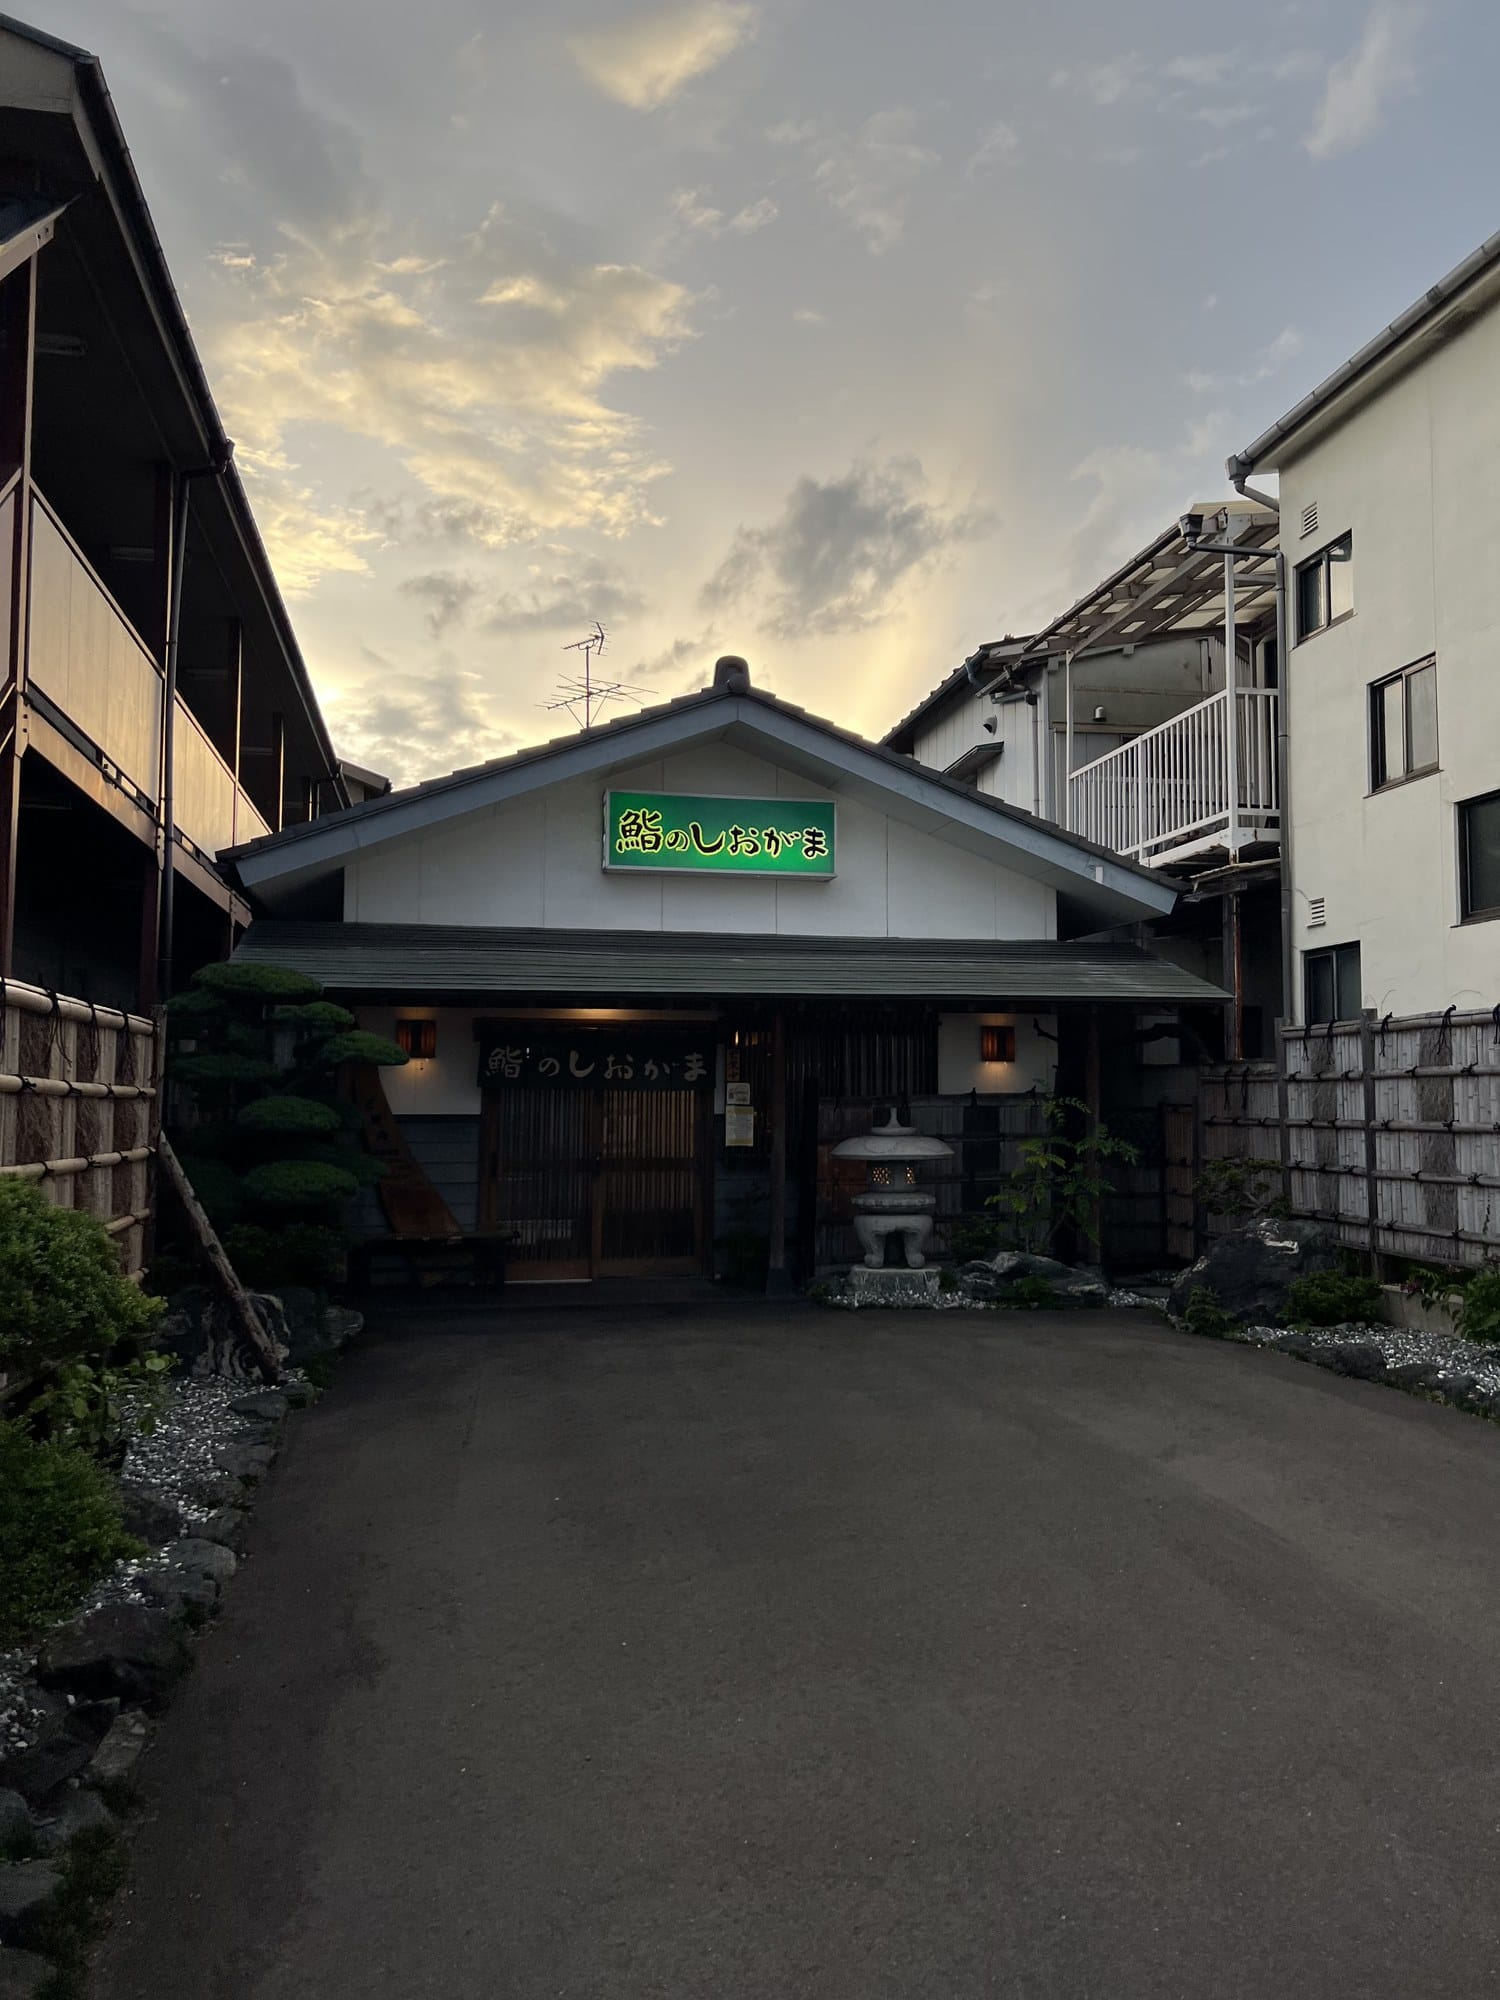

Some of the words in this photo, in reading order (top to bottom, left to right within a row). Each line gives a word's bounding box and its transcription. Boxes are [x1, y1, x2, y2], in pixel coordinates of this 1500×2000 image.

[616, 808, 829, 859] 鮨のしおがま
